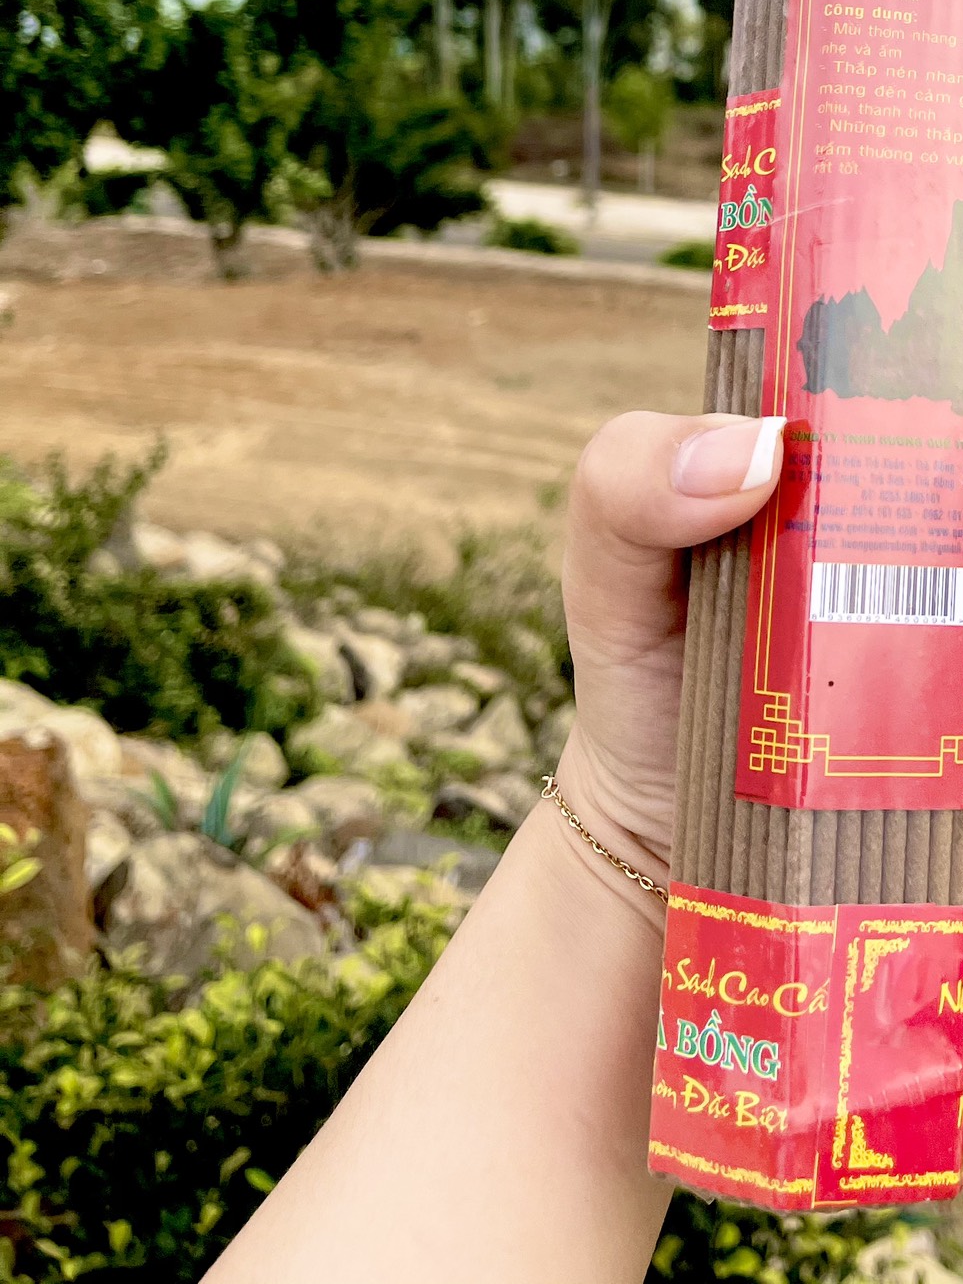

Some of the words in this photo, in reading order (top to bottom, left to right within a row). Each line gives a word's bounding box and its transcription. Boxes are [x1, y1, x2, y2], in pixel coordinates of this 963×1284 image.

[872, 7, 918, 24] dụng:
[913, 30, 957, 46] nhang
[855, 44, 871, 56] và
[819, 83, 867, 98] mang
[859, 103, 901, 118] thanh
[829, 119, 886, 137] Những
[721, 145, 752, 182] Sạch
[725, 243, 766, 273] Đặc
[676, 957, 716, 997] Sạch
[718, 971, 769, 1007] Cao
[674, 1009, 781, 1082] BỒNG
[681, 1074, 731, 1119] Đặc
[734, 1089, 789, 1133] Biệt
